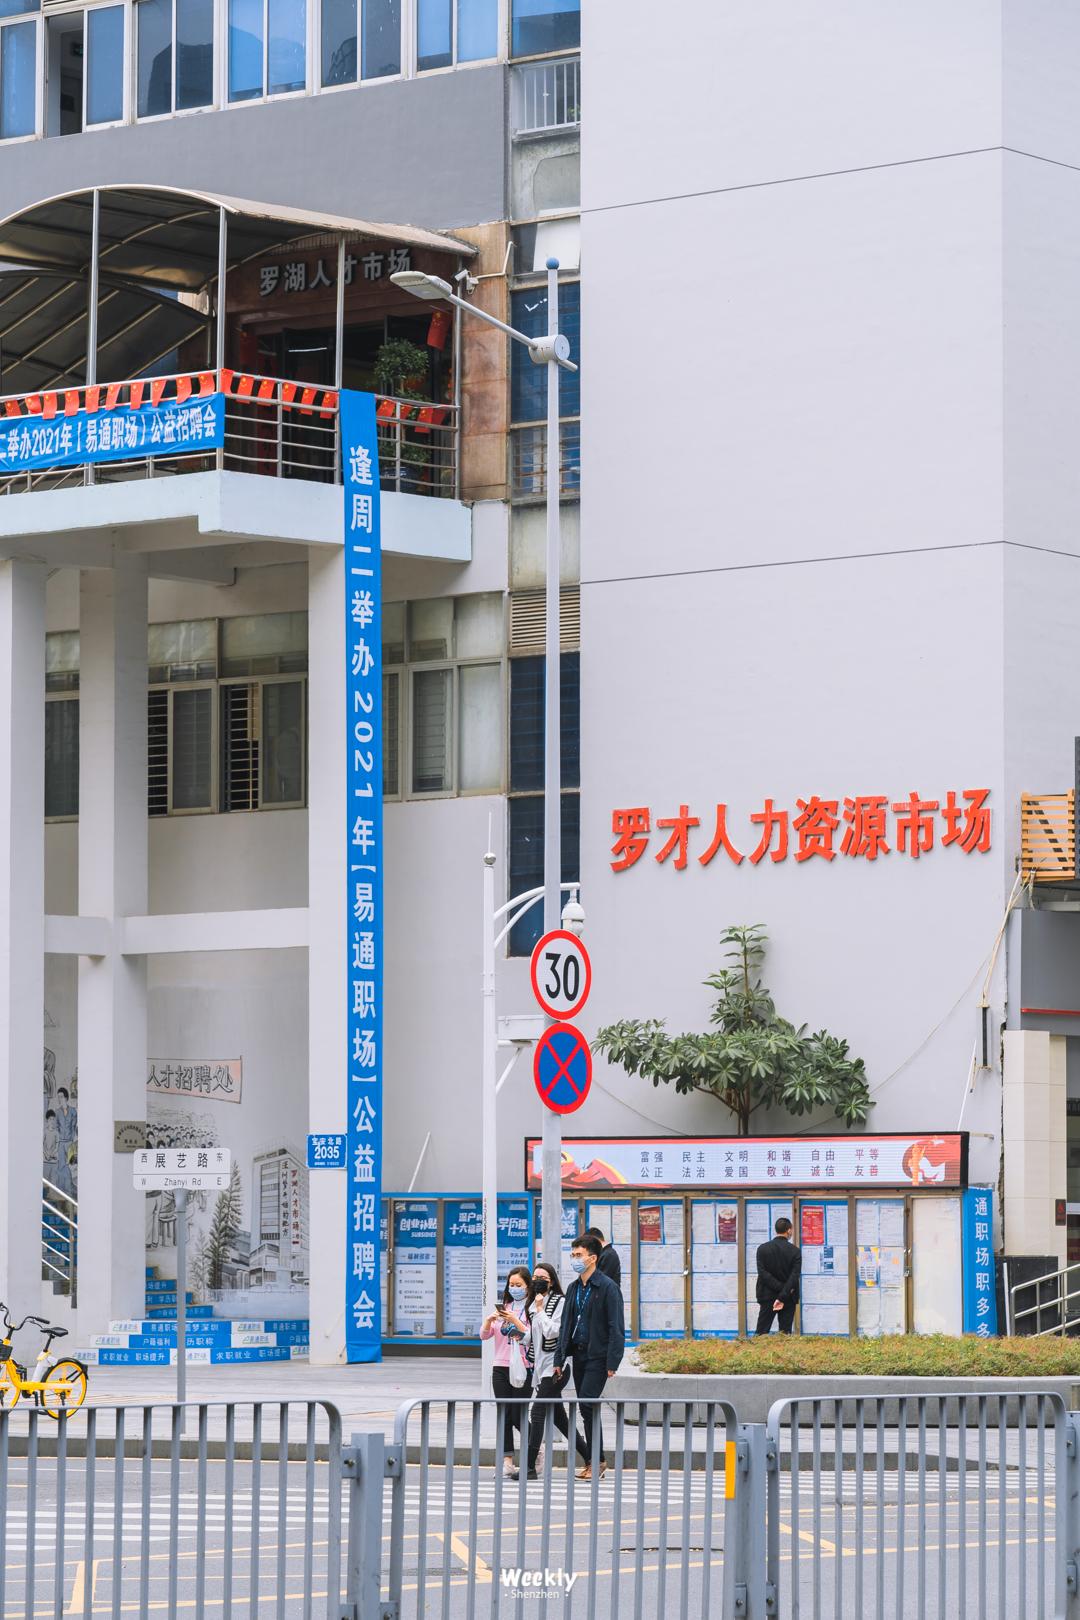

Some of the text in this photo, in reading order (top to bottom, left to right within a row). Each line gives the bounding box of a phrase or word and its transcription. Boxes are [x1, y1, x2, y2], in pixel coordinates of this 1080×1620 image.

[259, 248, 411, 297] 罗湖人才市场
[610, 788, 992, 872] 罗才人力资源市场
[545, 952, 580, 1001] 30
[146, 1064, 234, 1093] 人才招聘处
[141, 1153, 148, 1163] 西
[155, 1152, 208, 1168] 展艺路
[314, 1146, 340, 1159] 2035
[640, 1148, 880, 1163] 富强 民主 文明 和谐 自由 平等
[640, 1164, 880, 1178] 公正 法治 爱国 敬业 诚信 友善
[164, 1177, 188, 1188] Zhanyi
[191, 1177, 202, 1186] Rd
[216, 1177, 222, 1186] E
[975, 1187, 991, 1338] 通职场职多多
